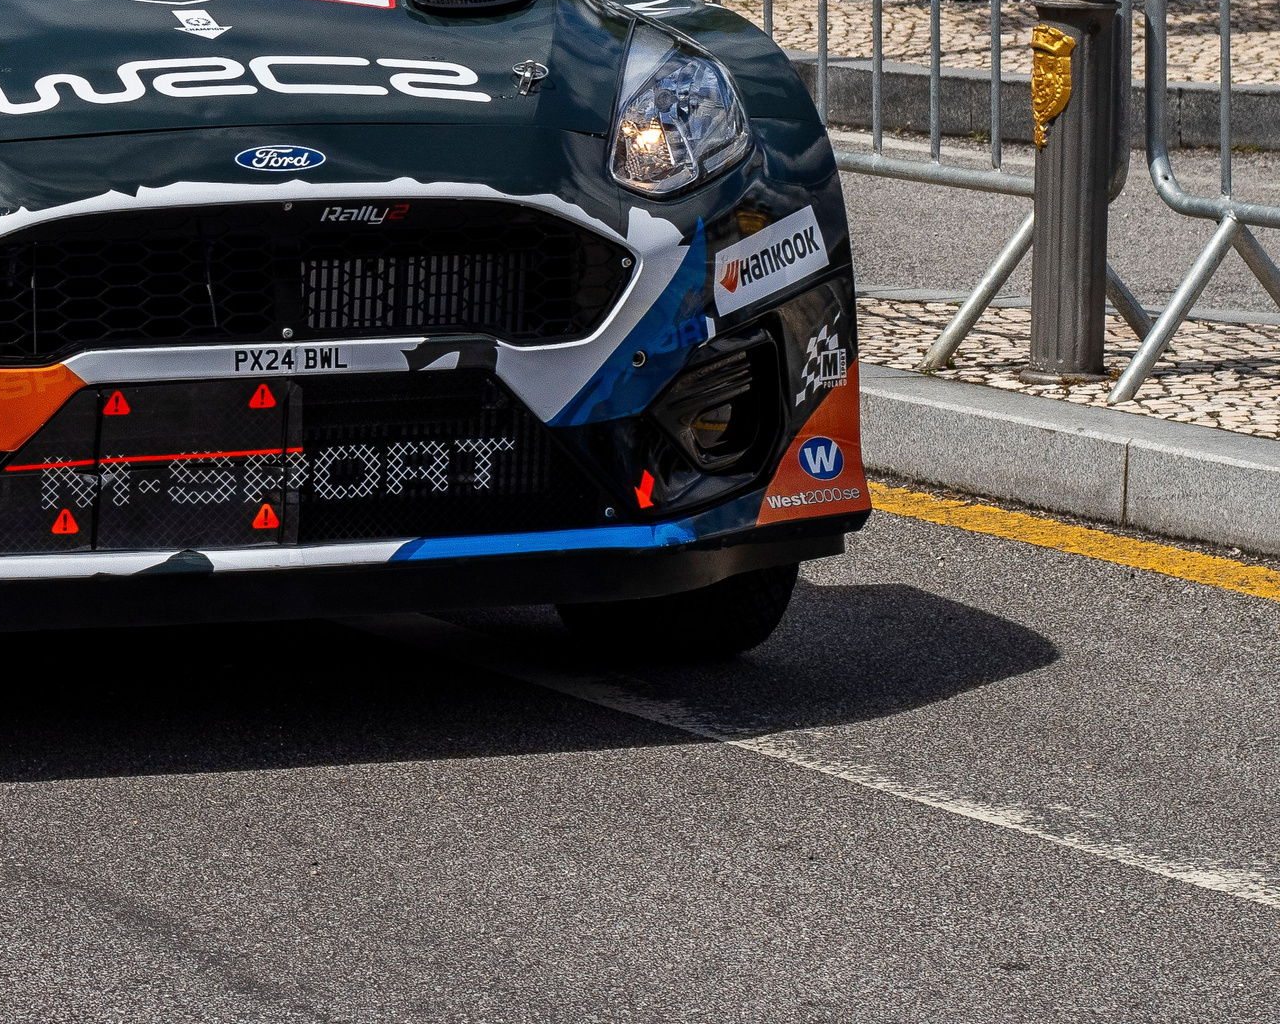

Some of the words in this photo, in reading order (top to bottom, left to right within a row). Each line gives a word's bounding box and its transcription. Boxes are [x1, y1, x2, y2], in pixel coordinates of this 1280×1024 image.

[253, 145, 312, 171] Ford
[320, 203, 411, 225] Rally2
[234, 347, 295, 373] PX24
[304, 346, 348, 370] BWL
[823, 378, 848, 388] POLAND
[803, 441, 840, 474] W
[766, 487, 861, 510] West2000.se
